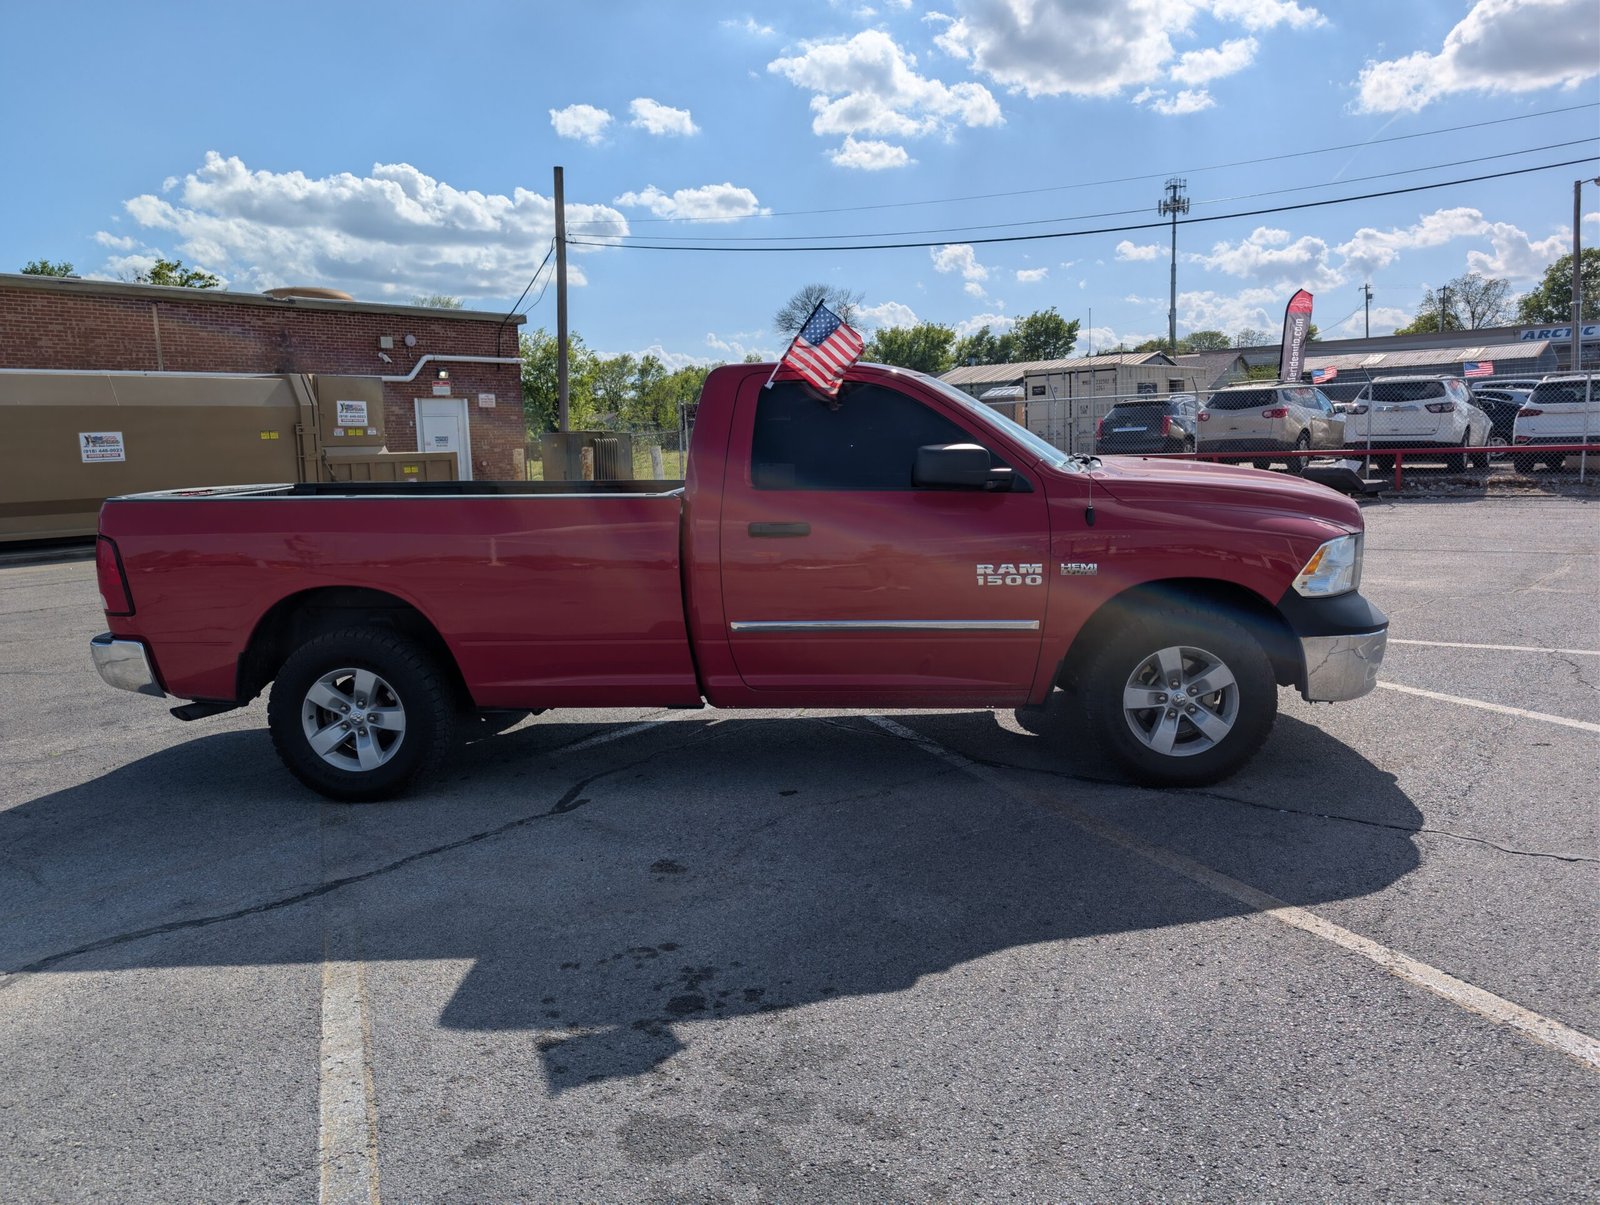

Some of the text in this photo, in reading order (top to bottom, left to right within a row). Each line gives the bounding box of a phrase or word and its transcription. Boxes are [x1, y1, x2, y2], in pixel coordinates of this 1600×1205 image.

[1522, 326, 1596, 340] ARCTC
[976, 563, 1042, 574] RAM
[977, 575, 1043, 586] 1500
